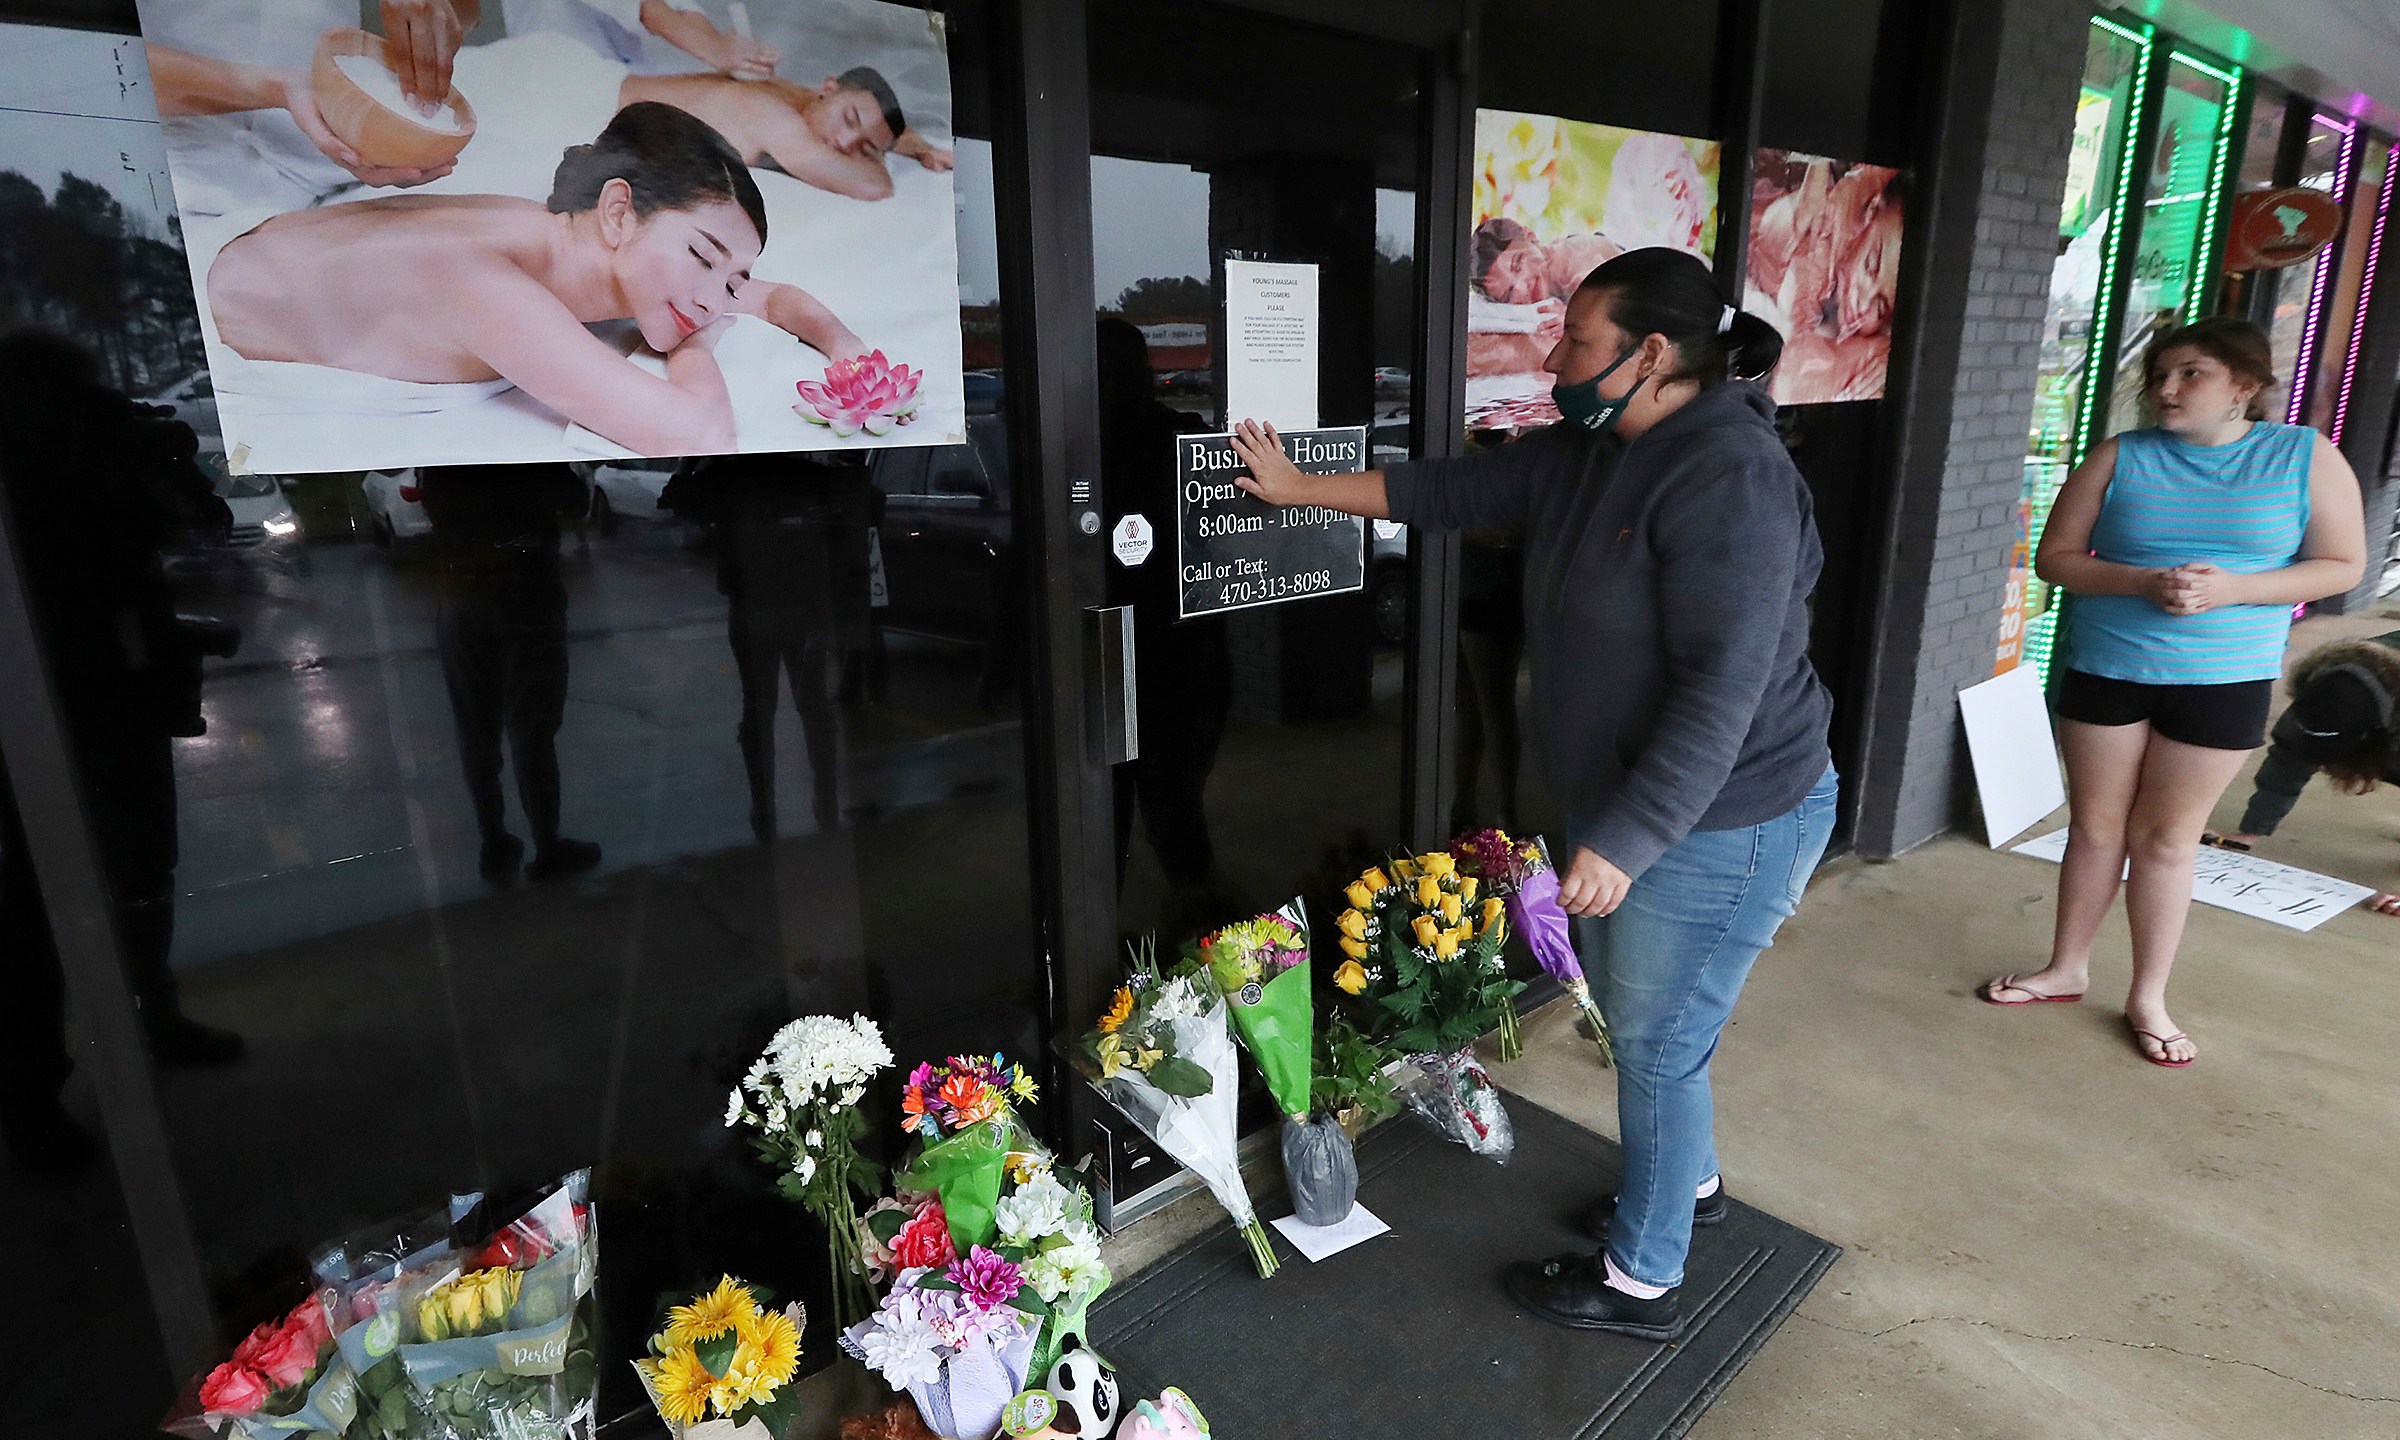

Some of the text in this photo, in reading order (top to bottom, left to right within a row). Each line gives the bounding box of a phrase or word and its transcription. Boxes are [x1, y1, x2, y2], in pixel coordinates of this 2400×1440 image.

[1252, 277, 1275, 285] YOUNG'S
[1260, 291, 1291, 299] CUSTOMERS
[1292, 437, 1356, 464] Hours
[1185, 480, 1235, 509] Open
[1199, 513, 1263, 537] 8:00am
[1280, 505, 1348, 530] 10:00pm
[1118, 540, 1148, 549] VECTOR
[1118, 547, 1148, 555] SECURITY
[1183, 558, 1268, 582] Call or Text:
[1220, 569, 1331, 604] 470-313-8098
